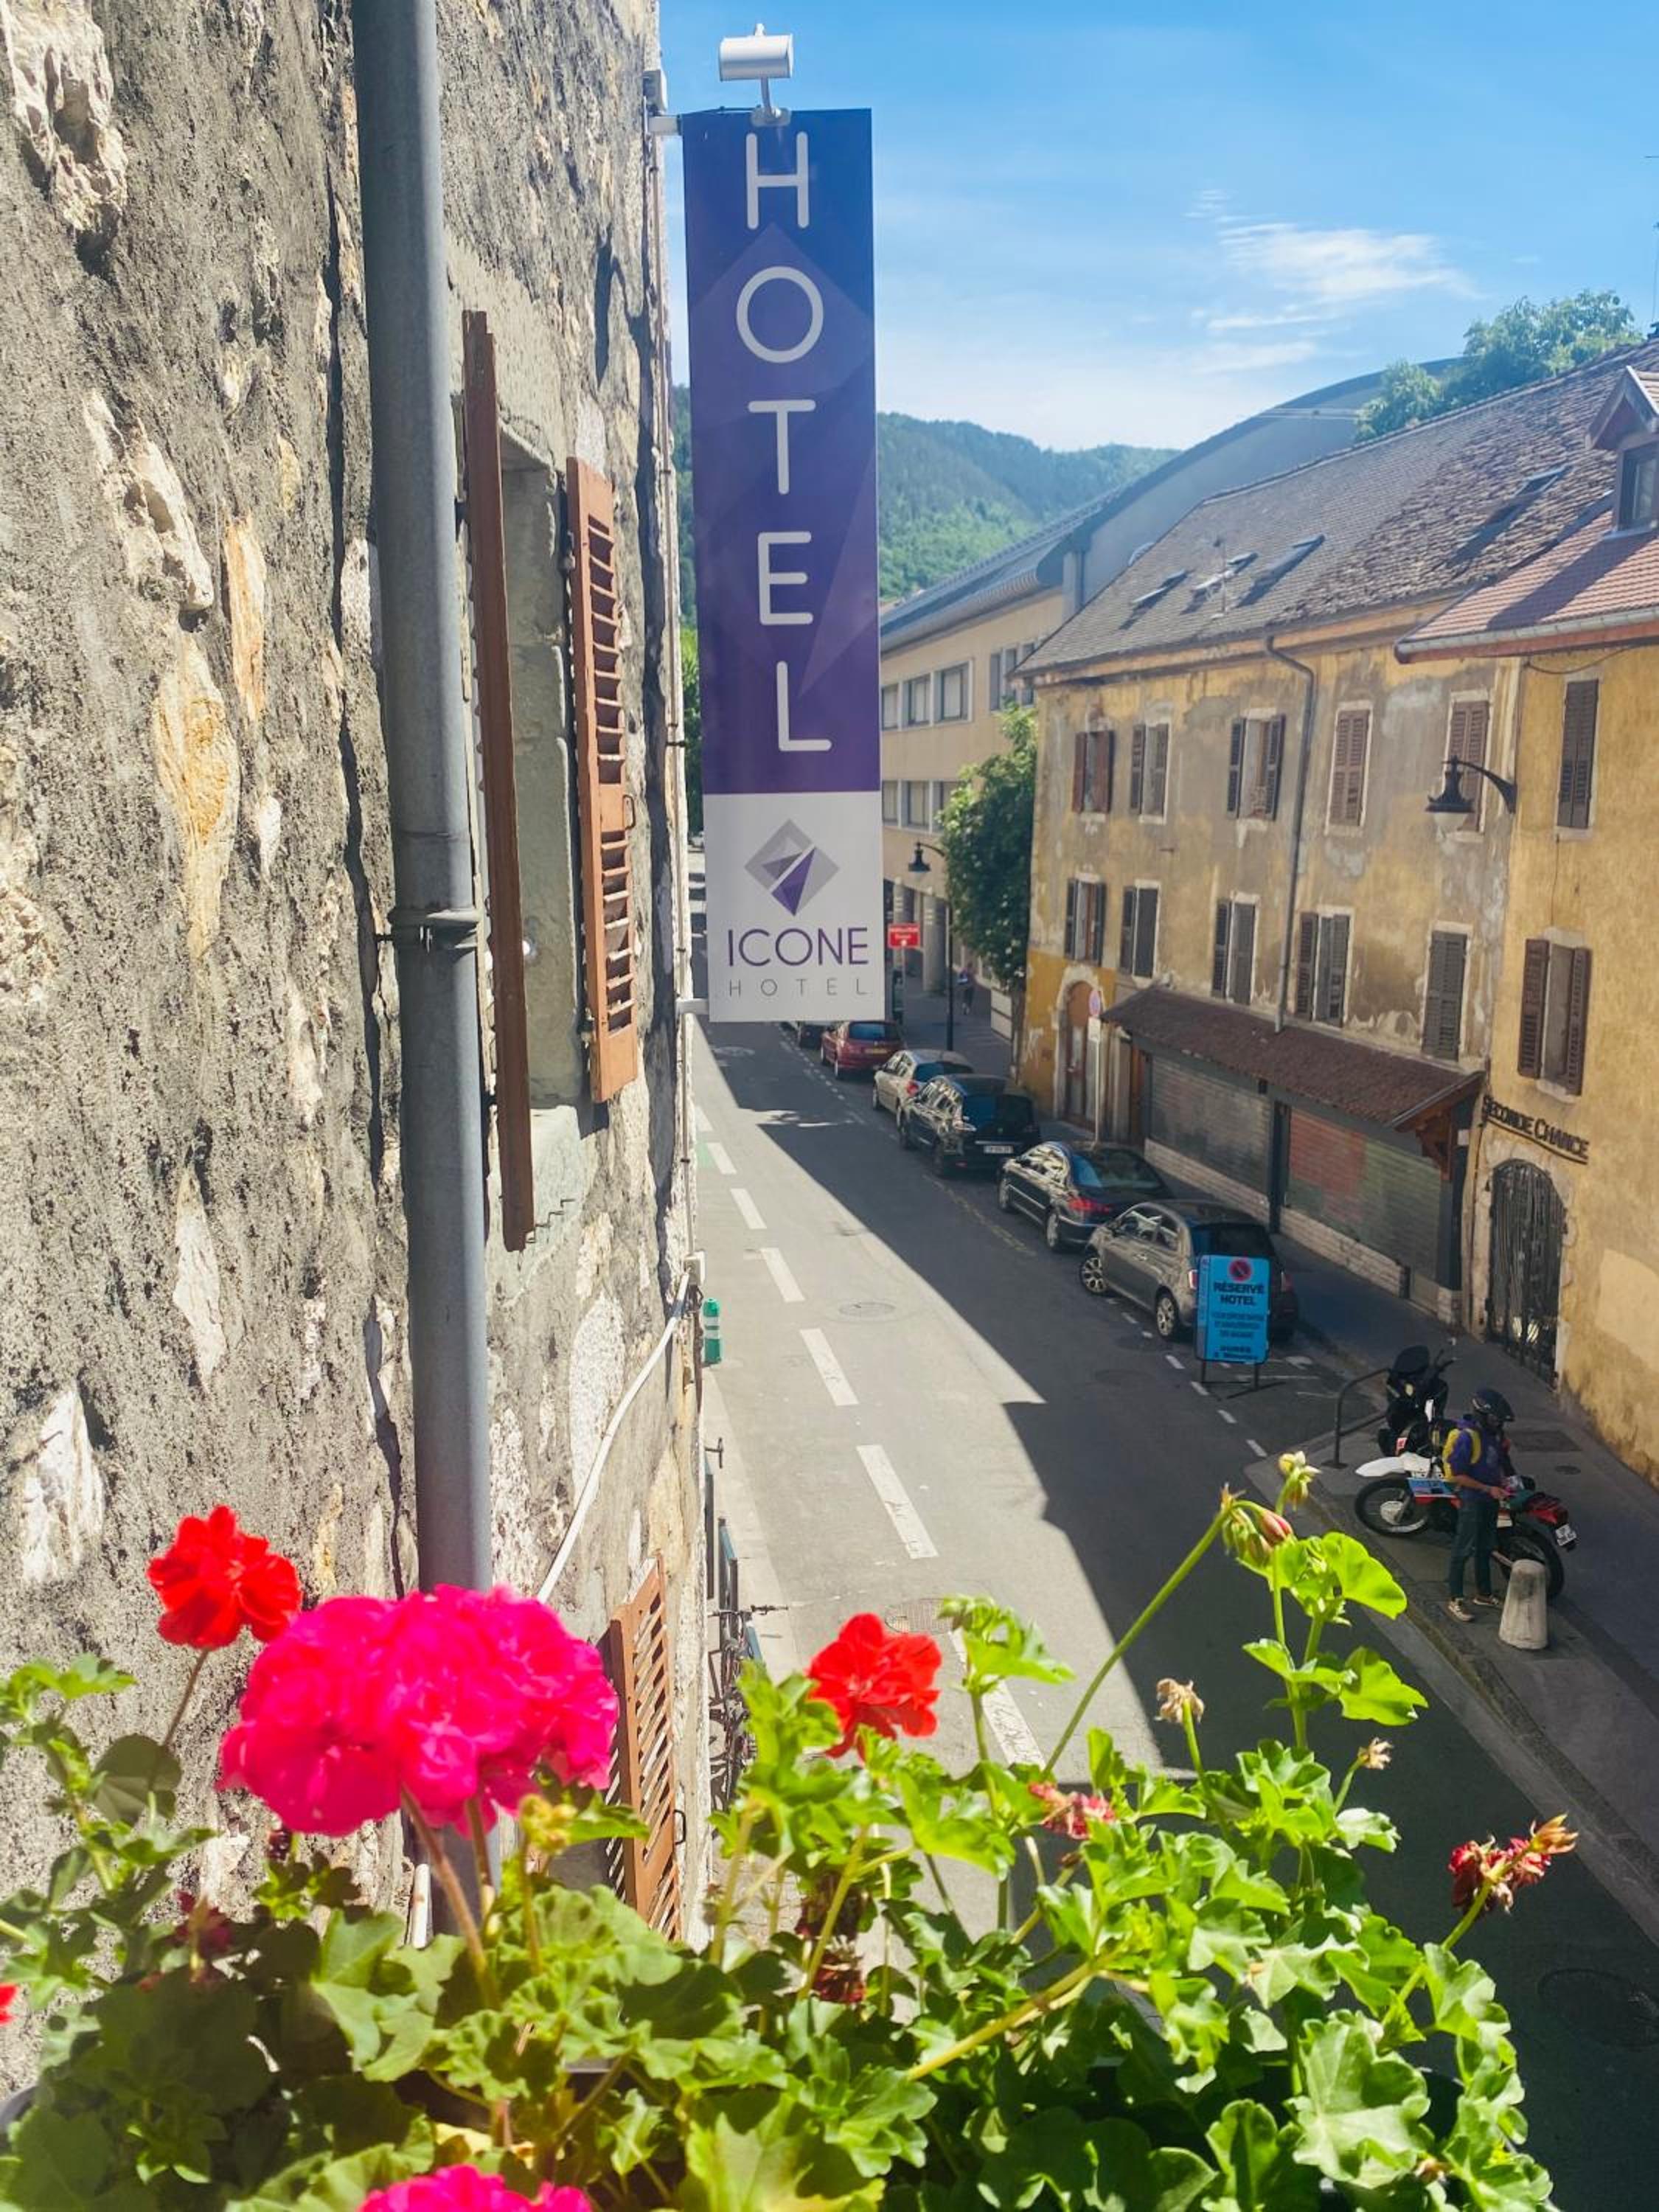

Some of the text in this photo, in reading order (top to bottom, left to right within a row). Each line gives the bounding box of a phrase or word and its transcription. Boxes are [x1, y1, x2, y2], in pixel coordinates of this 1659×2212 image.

[736, 131, 832, 752] HOTEL
[728, 927, 869, 967] ICONE
[728, 977, 869, 998] HOTEL
[1534, 1119, 1590, 1160] CHANCE
